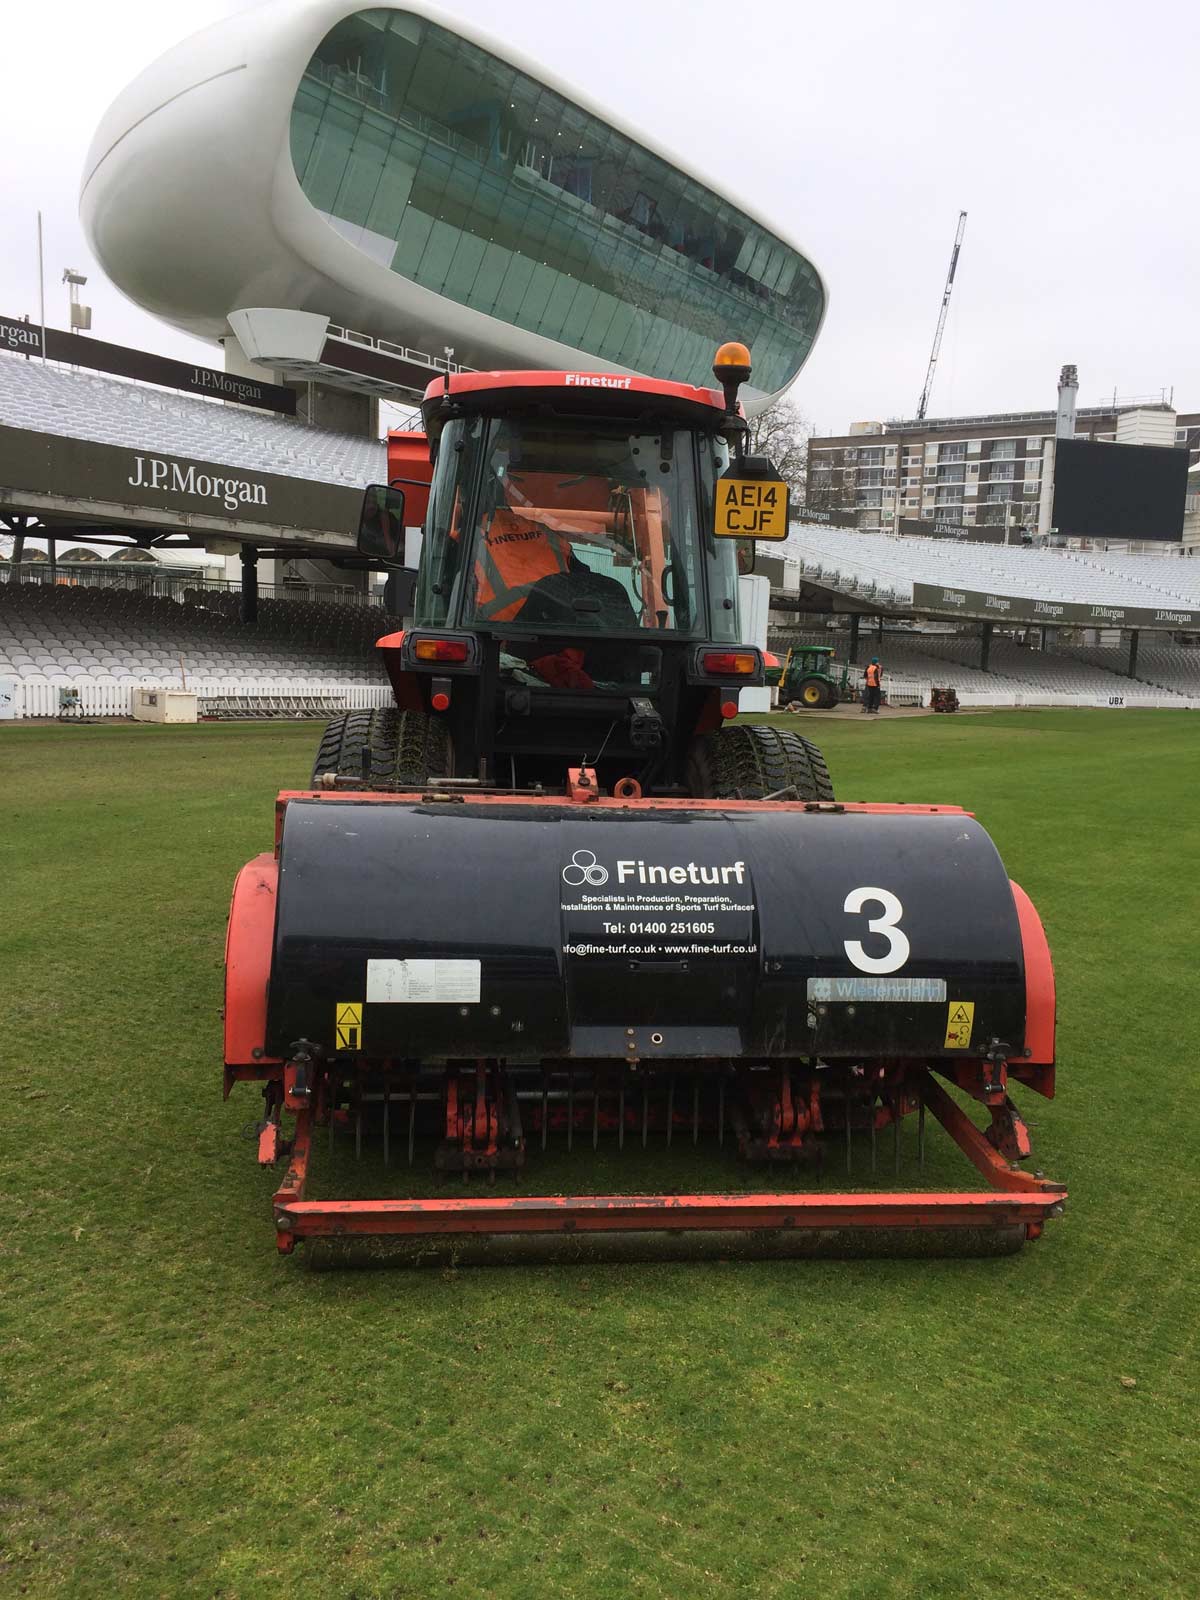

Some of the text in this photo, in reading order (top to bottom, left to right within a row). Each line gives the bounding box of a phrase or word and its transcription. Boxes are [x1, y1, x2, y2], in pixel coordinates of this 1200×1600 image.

[190, 368, 262, 400] J.P.Morgan
[565, 374, 631, 389] Fineturf
[128, 456, 268, 510] J.P.Morgan
[725, 485, 777, 508] AE14
[727, 509, 774, 531] CJF
[617, 860, 745, 884] Fineturf
[582, 894, 732, 904] Specialists in Production, Preparation,
[605, 903, 612, 911] &
[613, 903, 664, 911] Maintenance
[665, 903, 674, 911] of
[675, 903, 701, 912] Sports
[703, 903, 719, 911] Turf
[720, 903, 755, 911] Surfaces
[602, 922, 715, 934] Tel: 01400 251605
[843, 886, 910, 974] 3
